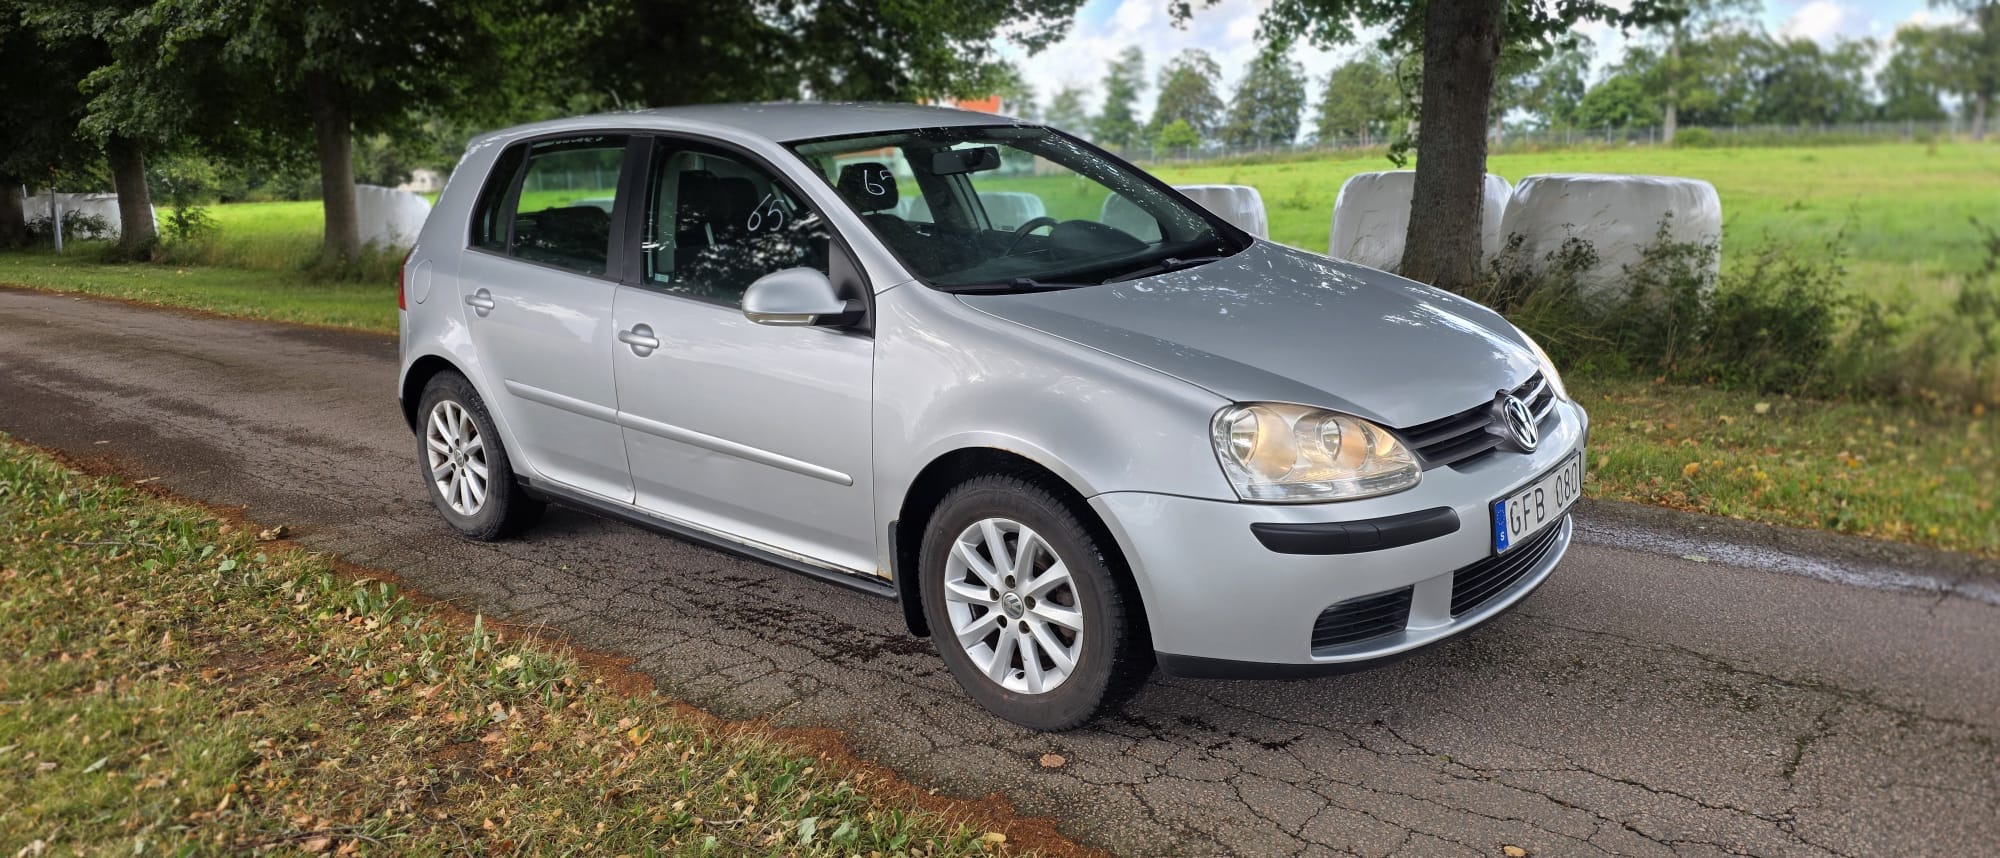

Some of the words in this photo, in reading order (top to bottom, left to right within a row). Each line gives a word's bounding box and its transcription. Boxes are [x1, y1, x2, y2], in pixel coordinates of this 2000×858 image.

[747, 193, 784, 231] 65
[1510, 487, 1545, 536] GFB
[1556, 462, 1578, 508] 080
[1500, 531, 1505, 541] S
